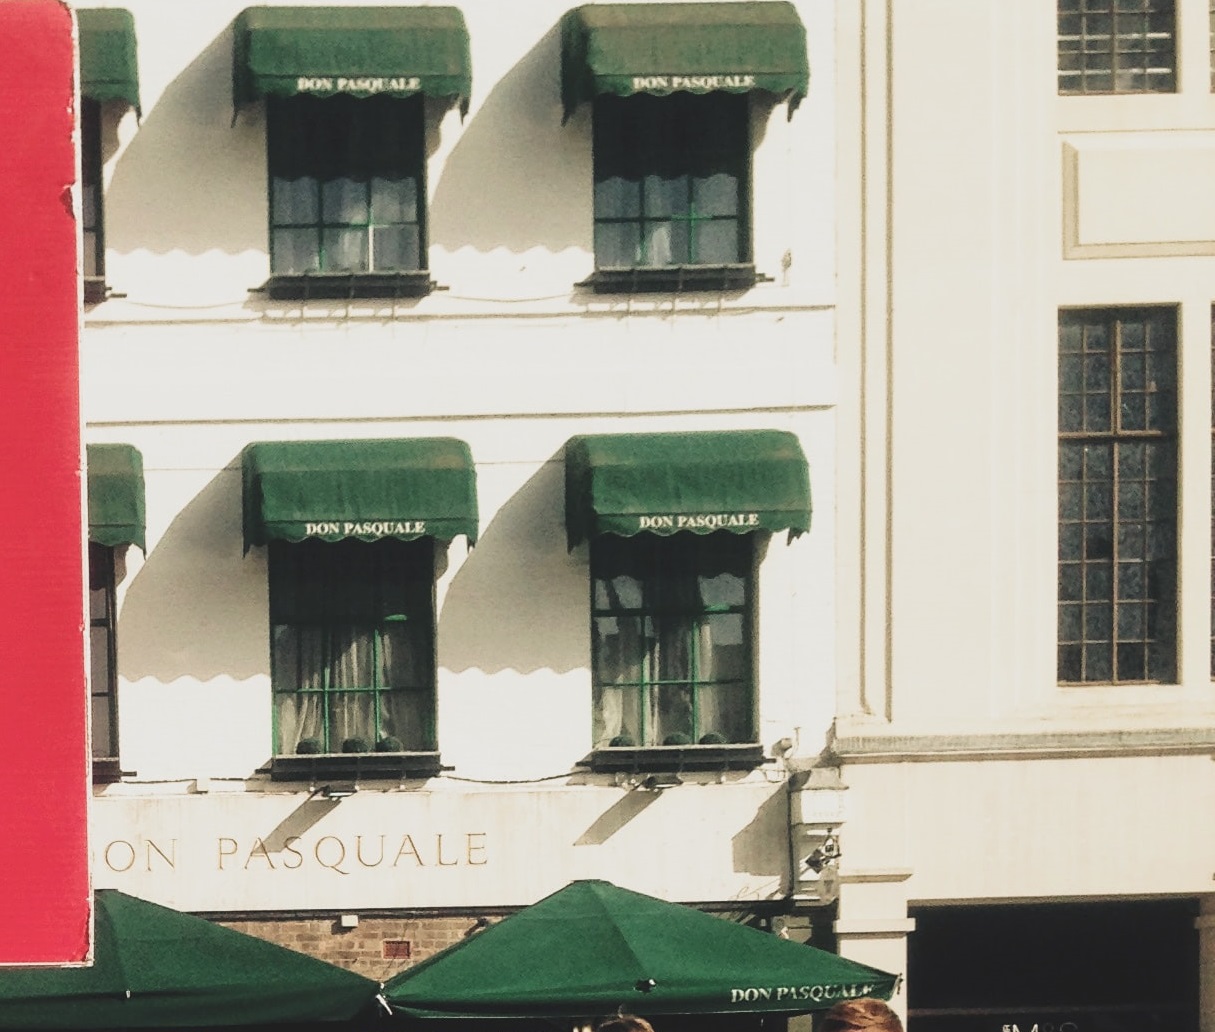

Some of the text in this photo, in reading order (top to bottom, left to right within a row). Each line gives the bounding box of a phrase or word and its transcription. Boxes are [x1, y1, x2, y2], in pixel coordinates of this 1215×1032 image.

[297, 77, 422, 94] DON PASQUALE
[633, 75, 756, 90] DON PASQUALE
[305, 521, 426, 536] DON PASQUALE
[639, 513, 760, 529] DON PASQUALE
[91, 832, 488, 875] ON PASQUALE
[730, 988, 772, 1003] DON
